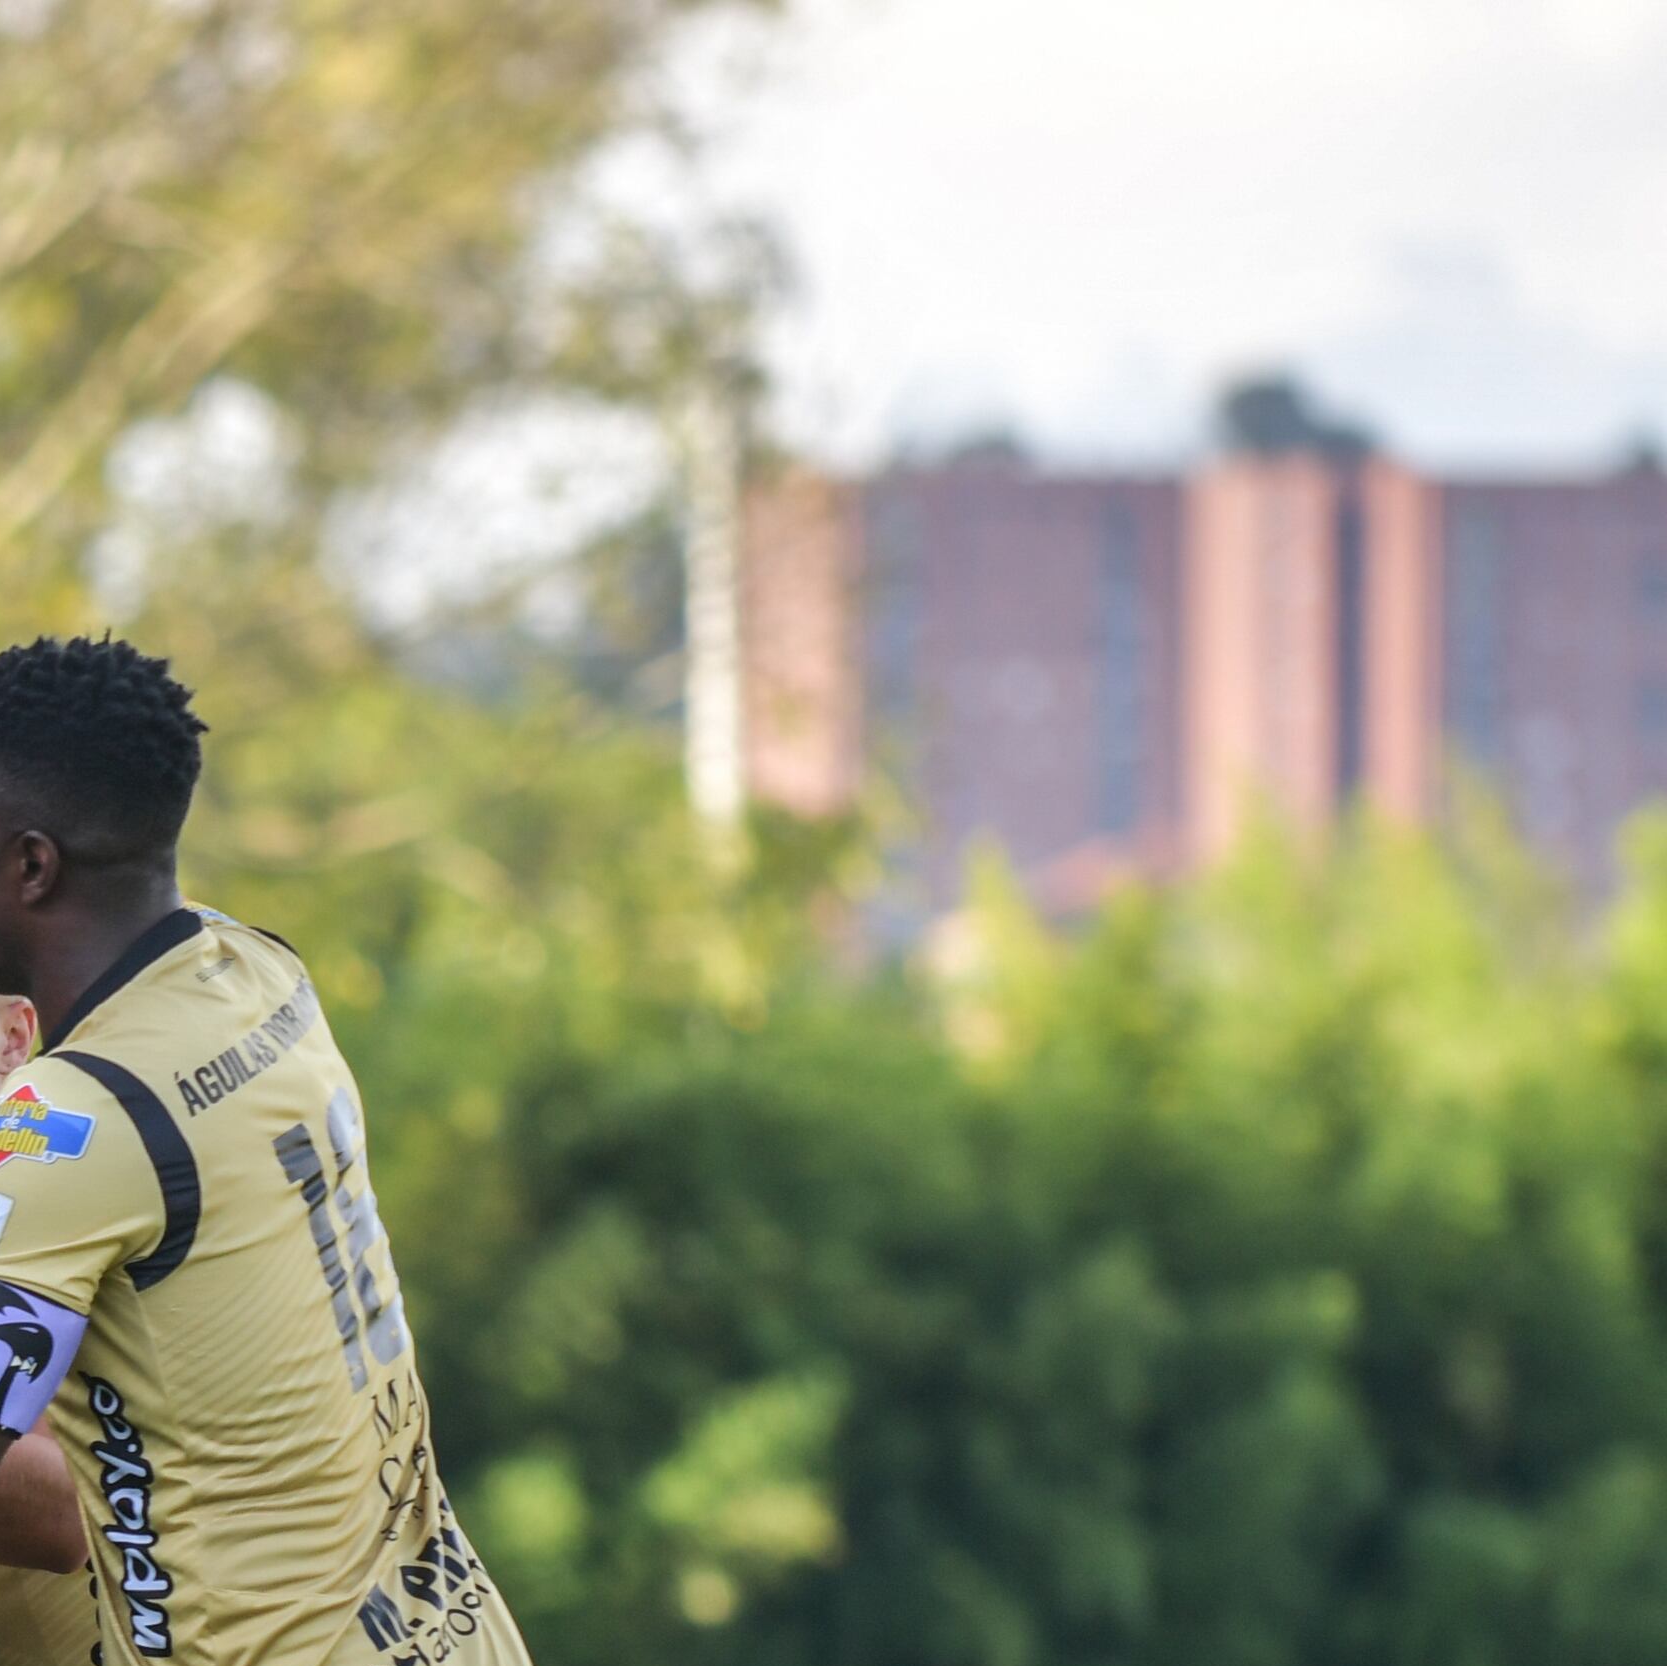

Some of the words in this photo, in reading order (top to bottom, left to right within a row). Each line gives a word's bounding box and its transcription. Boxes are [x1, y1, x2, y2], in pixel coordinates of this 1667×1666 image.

[174, 1030, 278, 1118] ÁGUILAS
[0, 1115, 21, 1130] de
[86, 1383, 169, 1651] wplay.co
